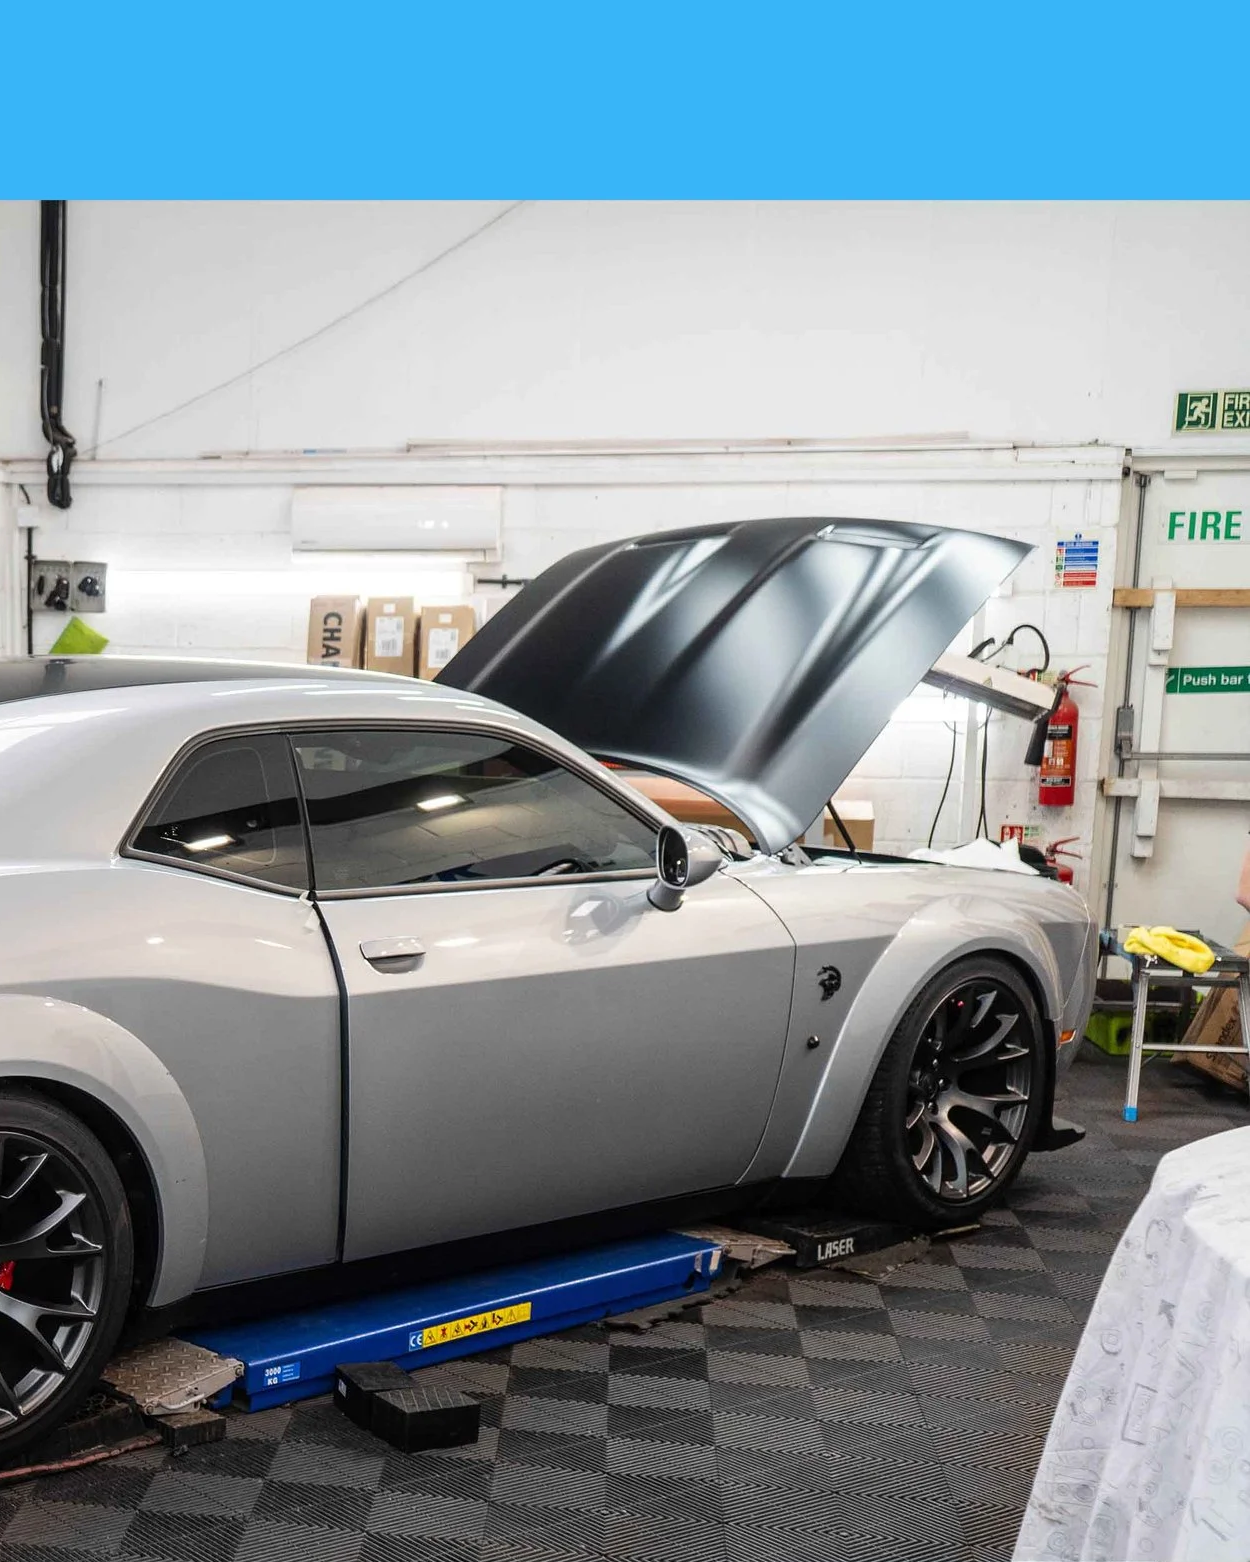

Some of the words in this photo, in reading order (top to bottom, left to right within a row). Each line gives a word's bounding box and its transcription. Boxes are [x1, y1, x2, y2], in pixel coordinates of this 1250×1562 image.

[1168, 511, 1242, 540] FIRE
[1183, 673, 1217, 686] Push
[1221, 673, 1244, 685] bar
[817, 1237, 854, 1261] LASER
[265, 1366, 281, 1377] 3000
[267, 1377, 278, 1386] KG
